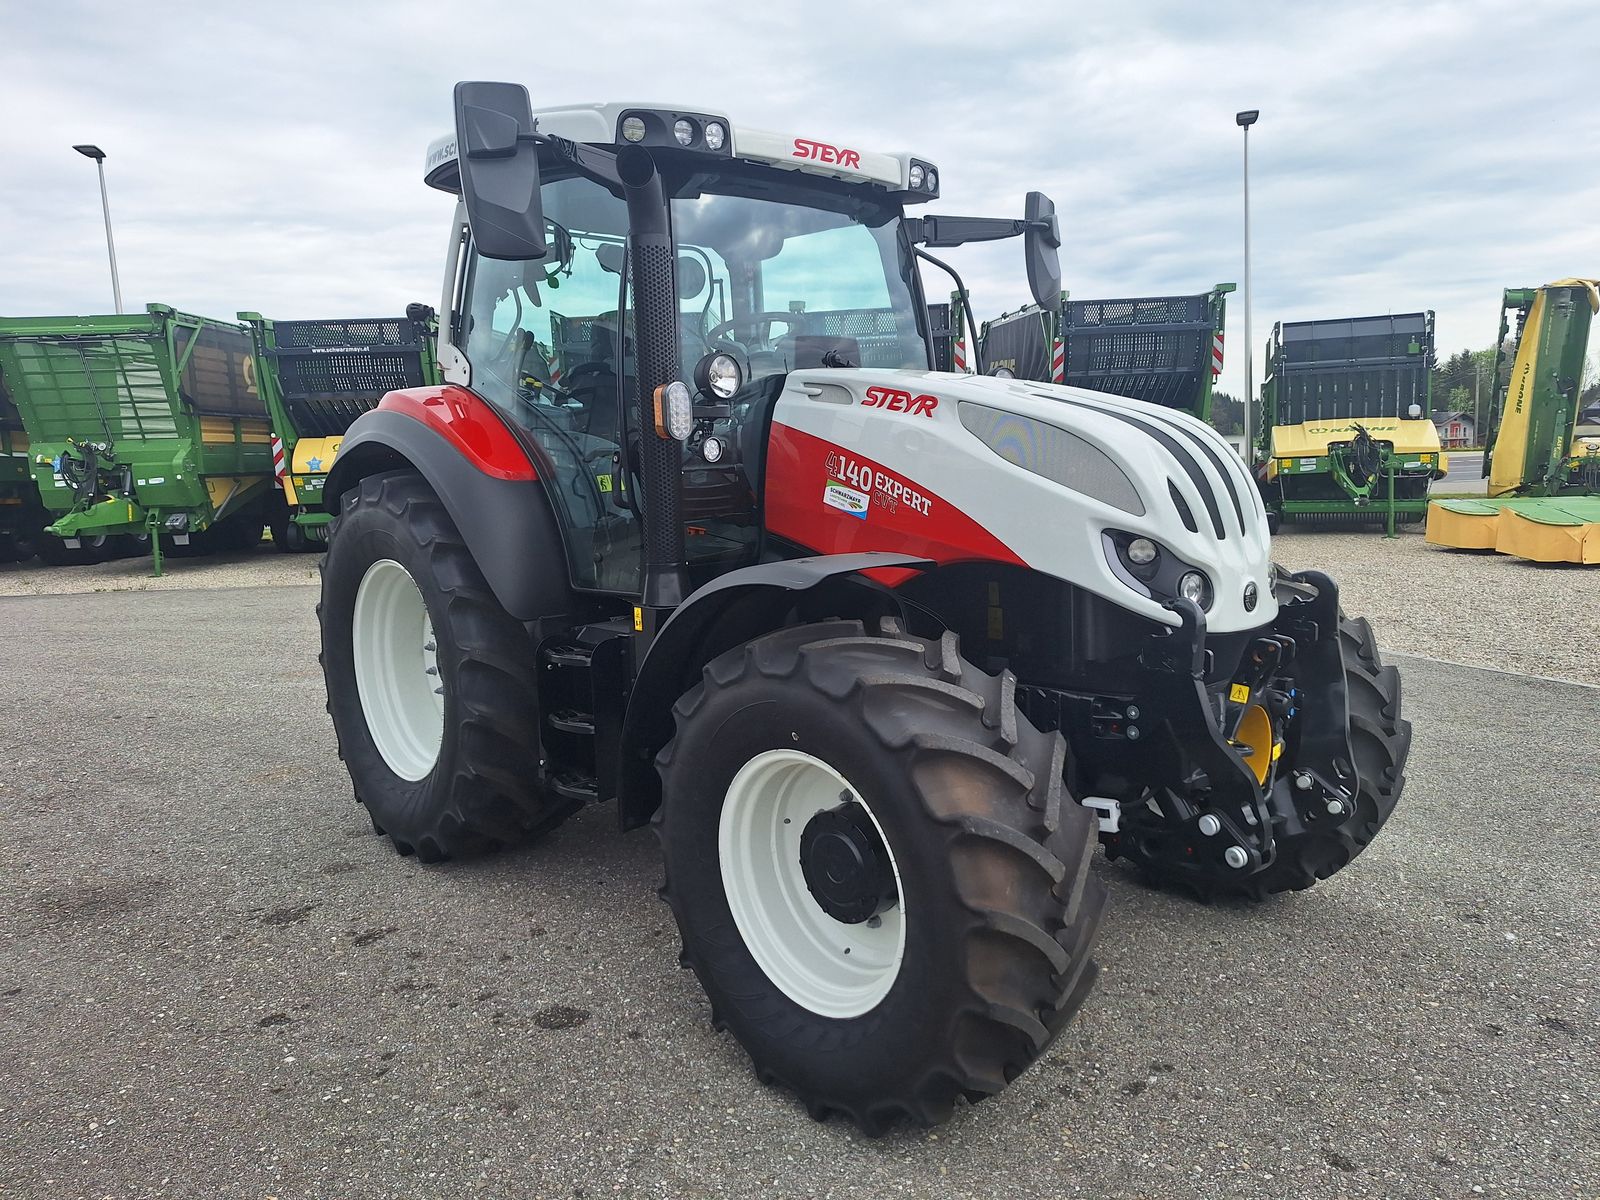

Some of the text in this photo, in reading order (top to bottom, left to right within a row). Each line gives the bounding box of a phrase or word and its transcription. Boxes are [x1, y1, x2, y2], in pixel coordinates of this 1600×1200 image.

[793, 139, 860, 169] STEYR
[861, 386, 938, 418] STEYR
[825, 450, 932, 516] 4140 EXPERT
[873, 490, 898, 514] CVT
